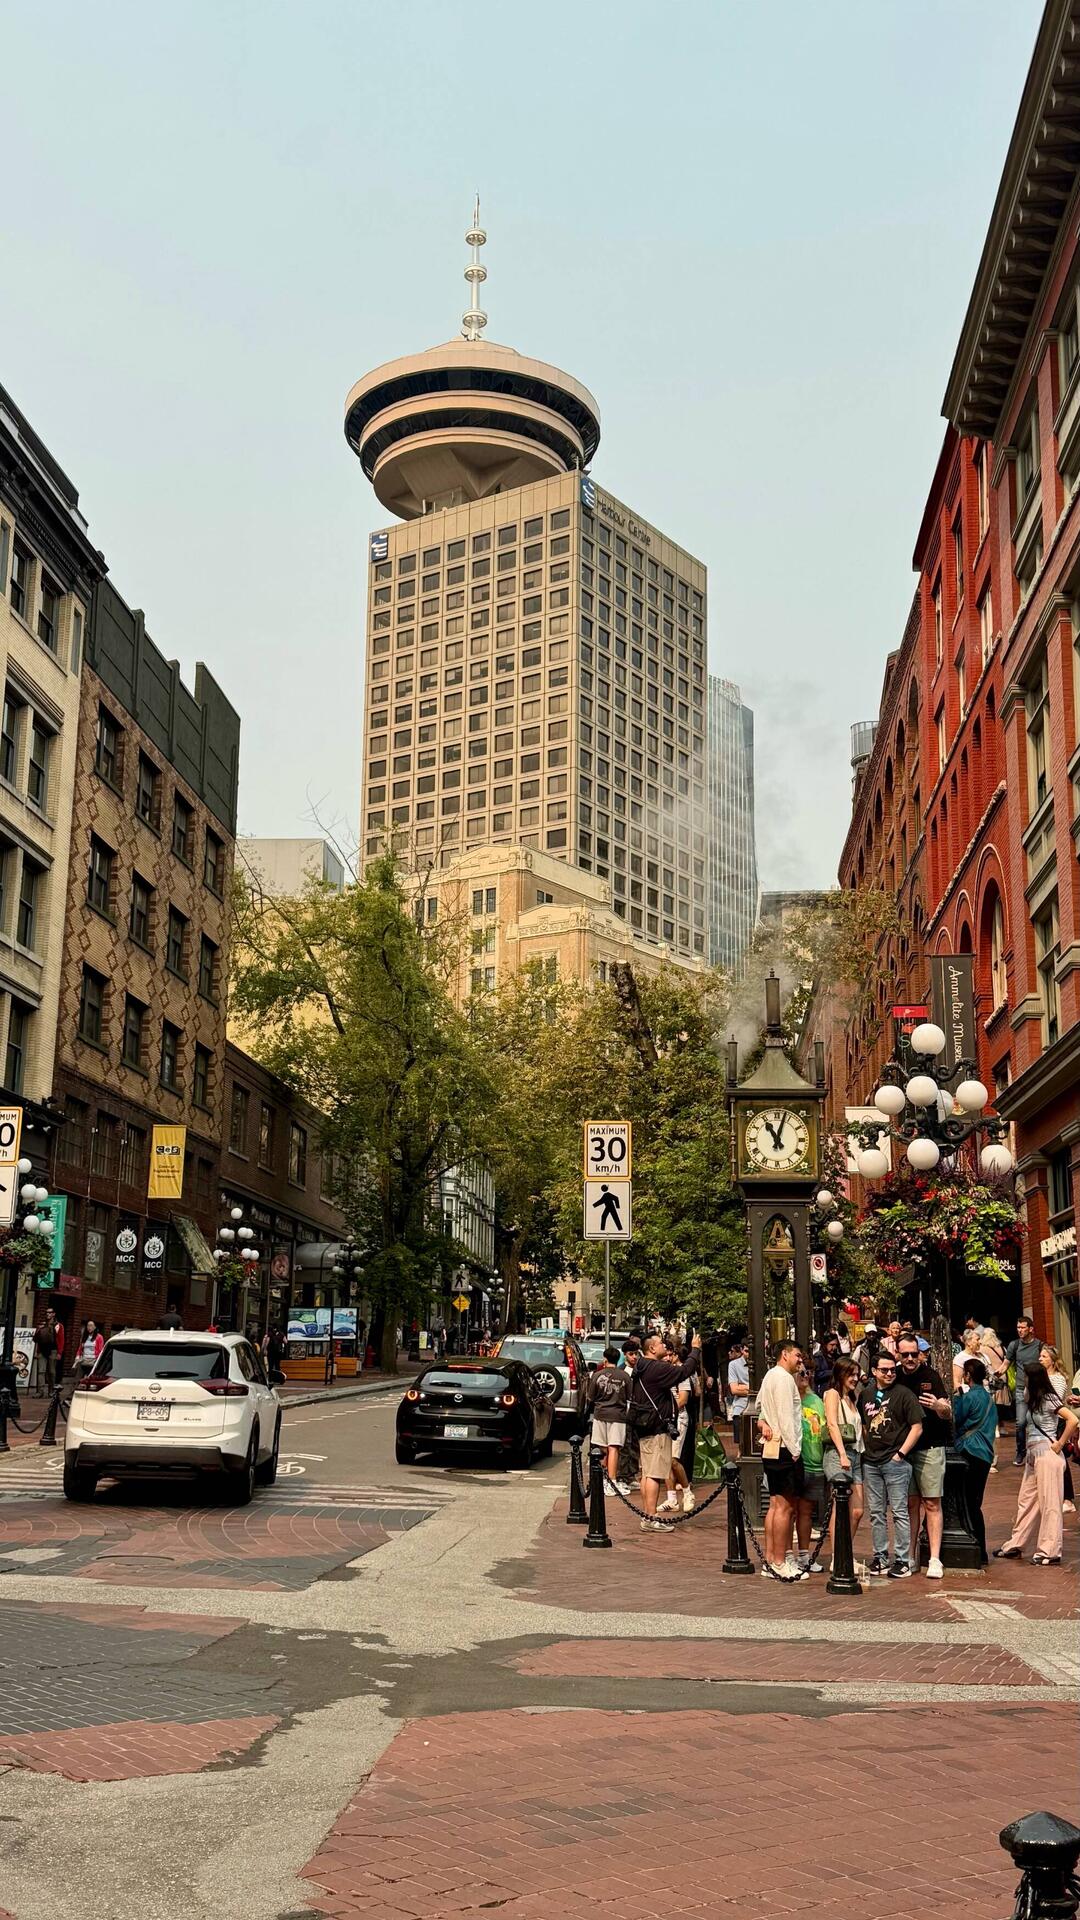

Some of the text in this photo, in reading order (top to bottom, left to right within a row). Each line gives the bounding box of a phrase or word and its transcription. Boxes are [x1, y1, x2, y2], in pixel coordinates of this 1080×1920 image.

[0, 1122, 16, 1147] 0
[590, 1127, 626, 1135] MAXIMUM
[590, 1136, 626, 1162] 30
[595, 1164, 621, 1173] km/h
[115, 1254, 135, 1263] MCC
[144, 1261, 162, 1269] MCC
